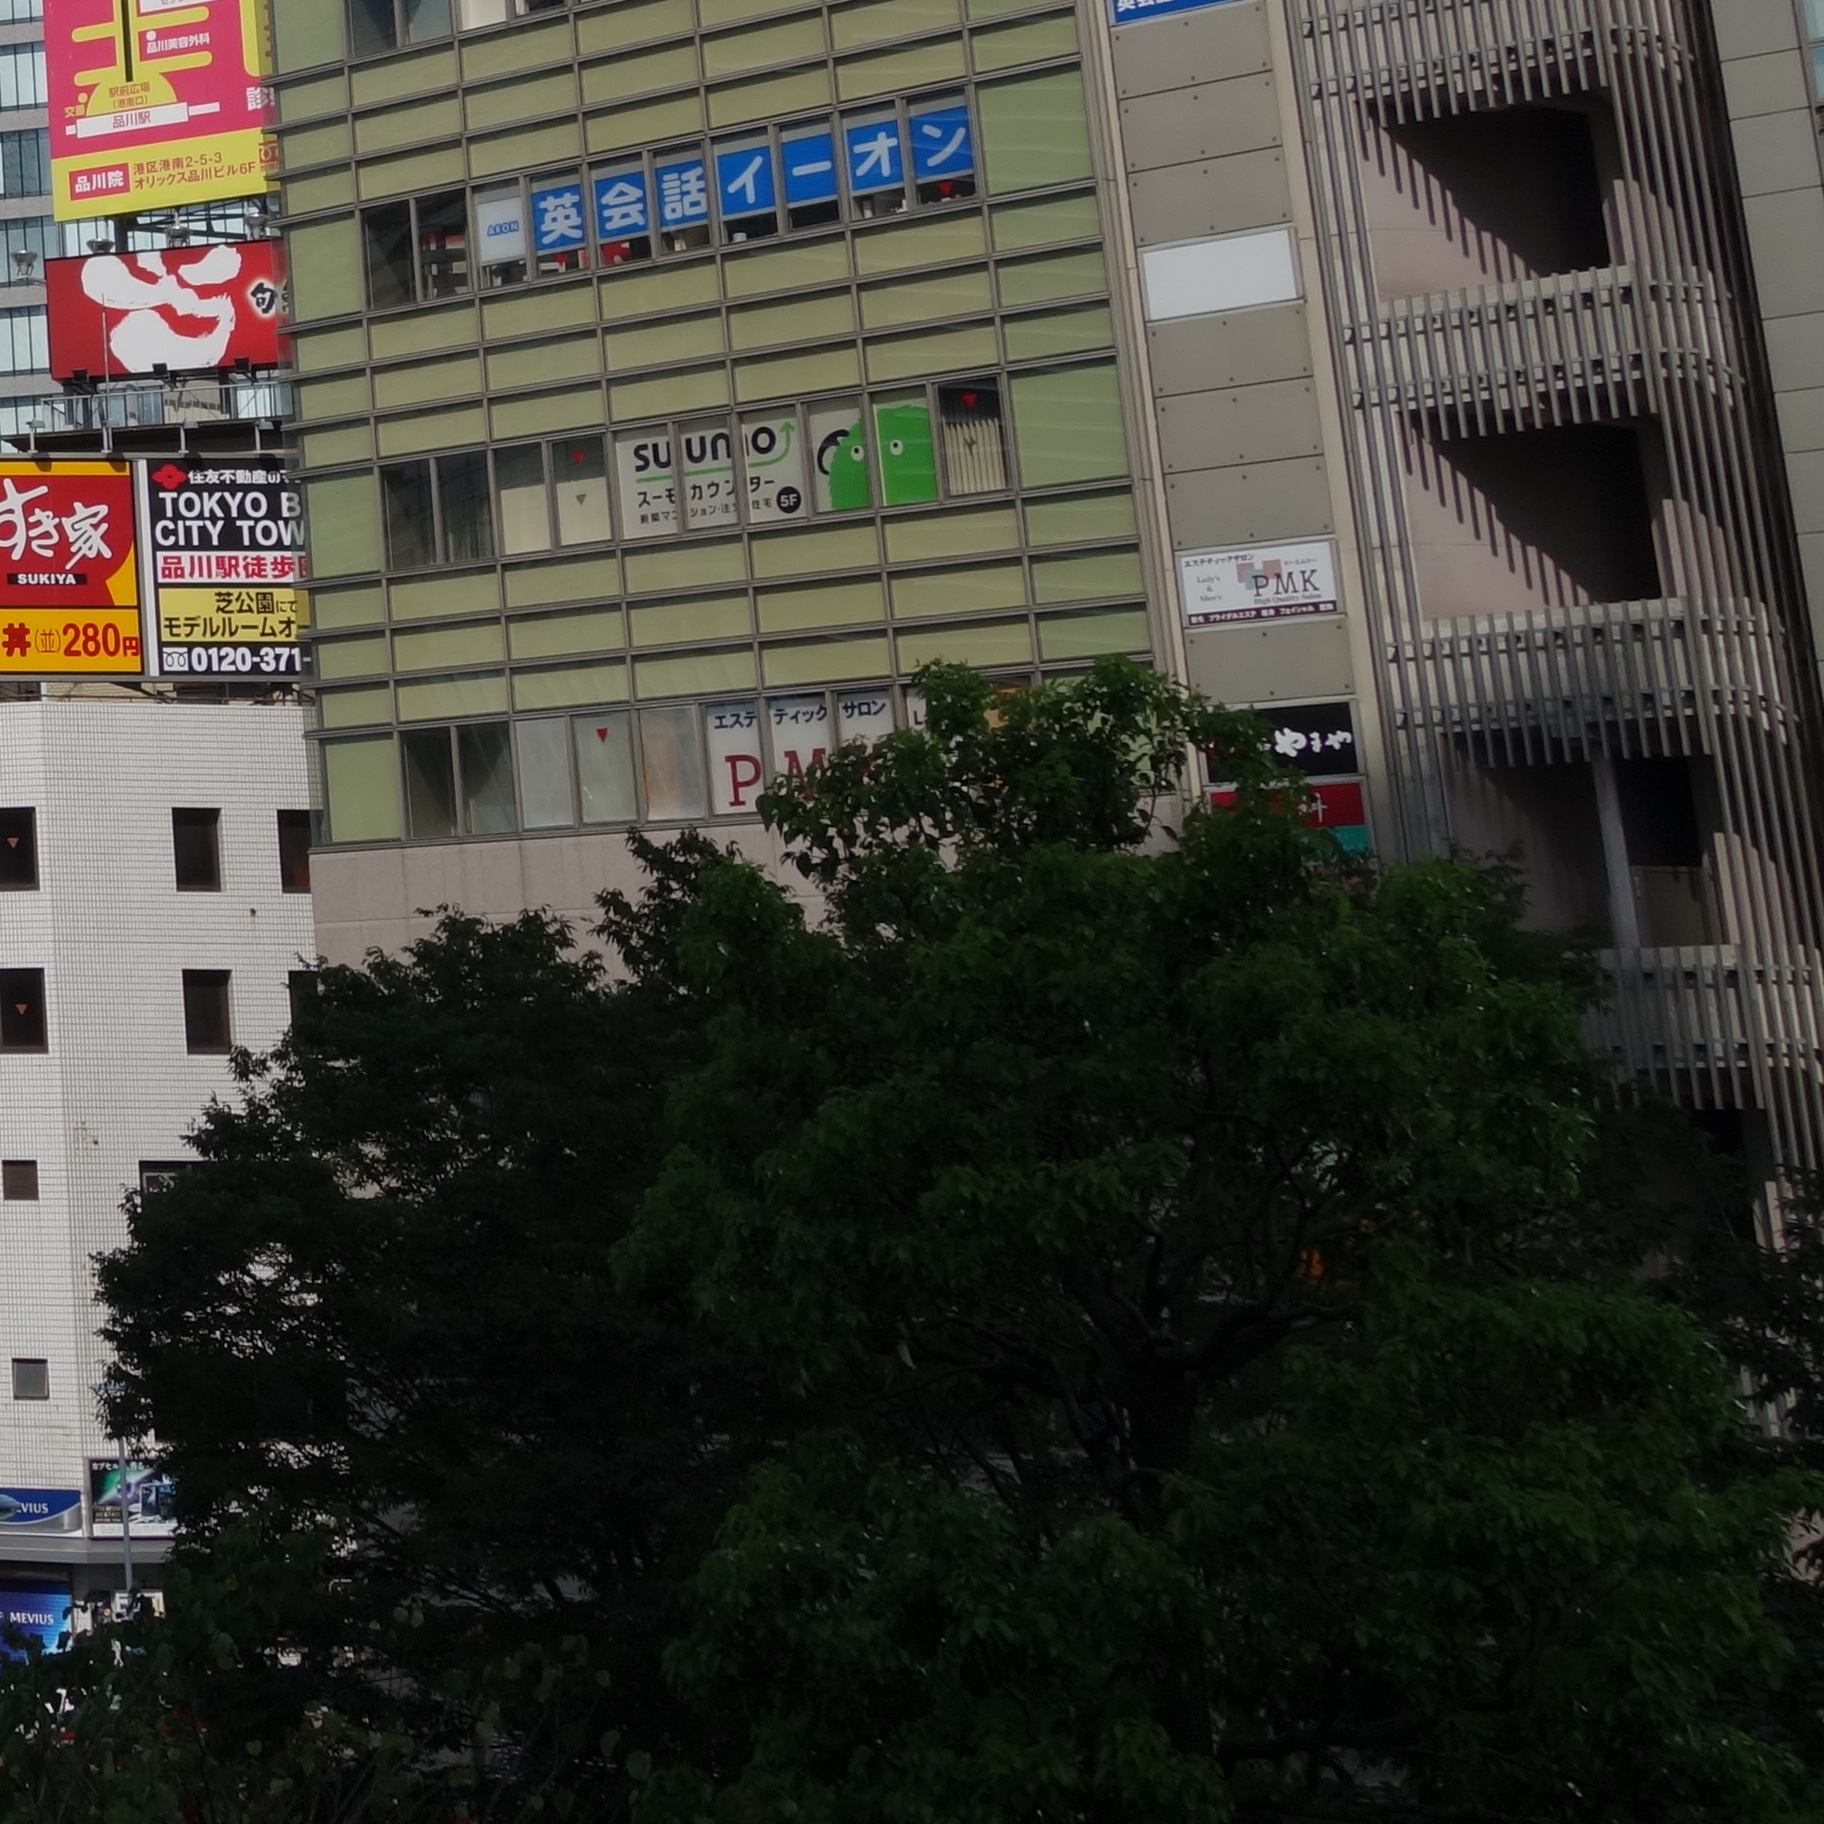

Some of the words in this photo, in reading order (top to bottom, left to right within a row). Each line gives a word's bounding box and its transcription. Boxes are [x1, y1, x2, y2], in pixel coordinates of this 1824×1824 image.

[147, 32, 210, 54] 品川美容外科
[109, 83, 150, 97] 駅前広場
[113, 112, 151, 128] 品川駅
[134, 152, 222, 175] 港区港南2-5-3
[75, 171, 124, 193] 品川院
[135, 162, 256, 189] オリックス品川ビル6F
[539, 122, 970, 246] 英会話イーオン
[159, 492, 268, 518] TOKYO
[780, 493, 798, 507] 5F
[156, 520, 224, 546] CITY
[18, 573, 77, 585] SUKIYA
[1252, 569, 1320, 597] PMK
[215, 592, 298, 614] 芝公園にて
[10, 1610, 55, 1626] MEVIUS
